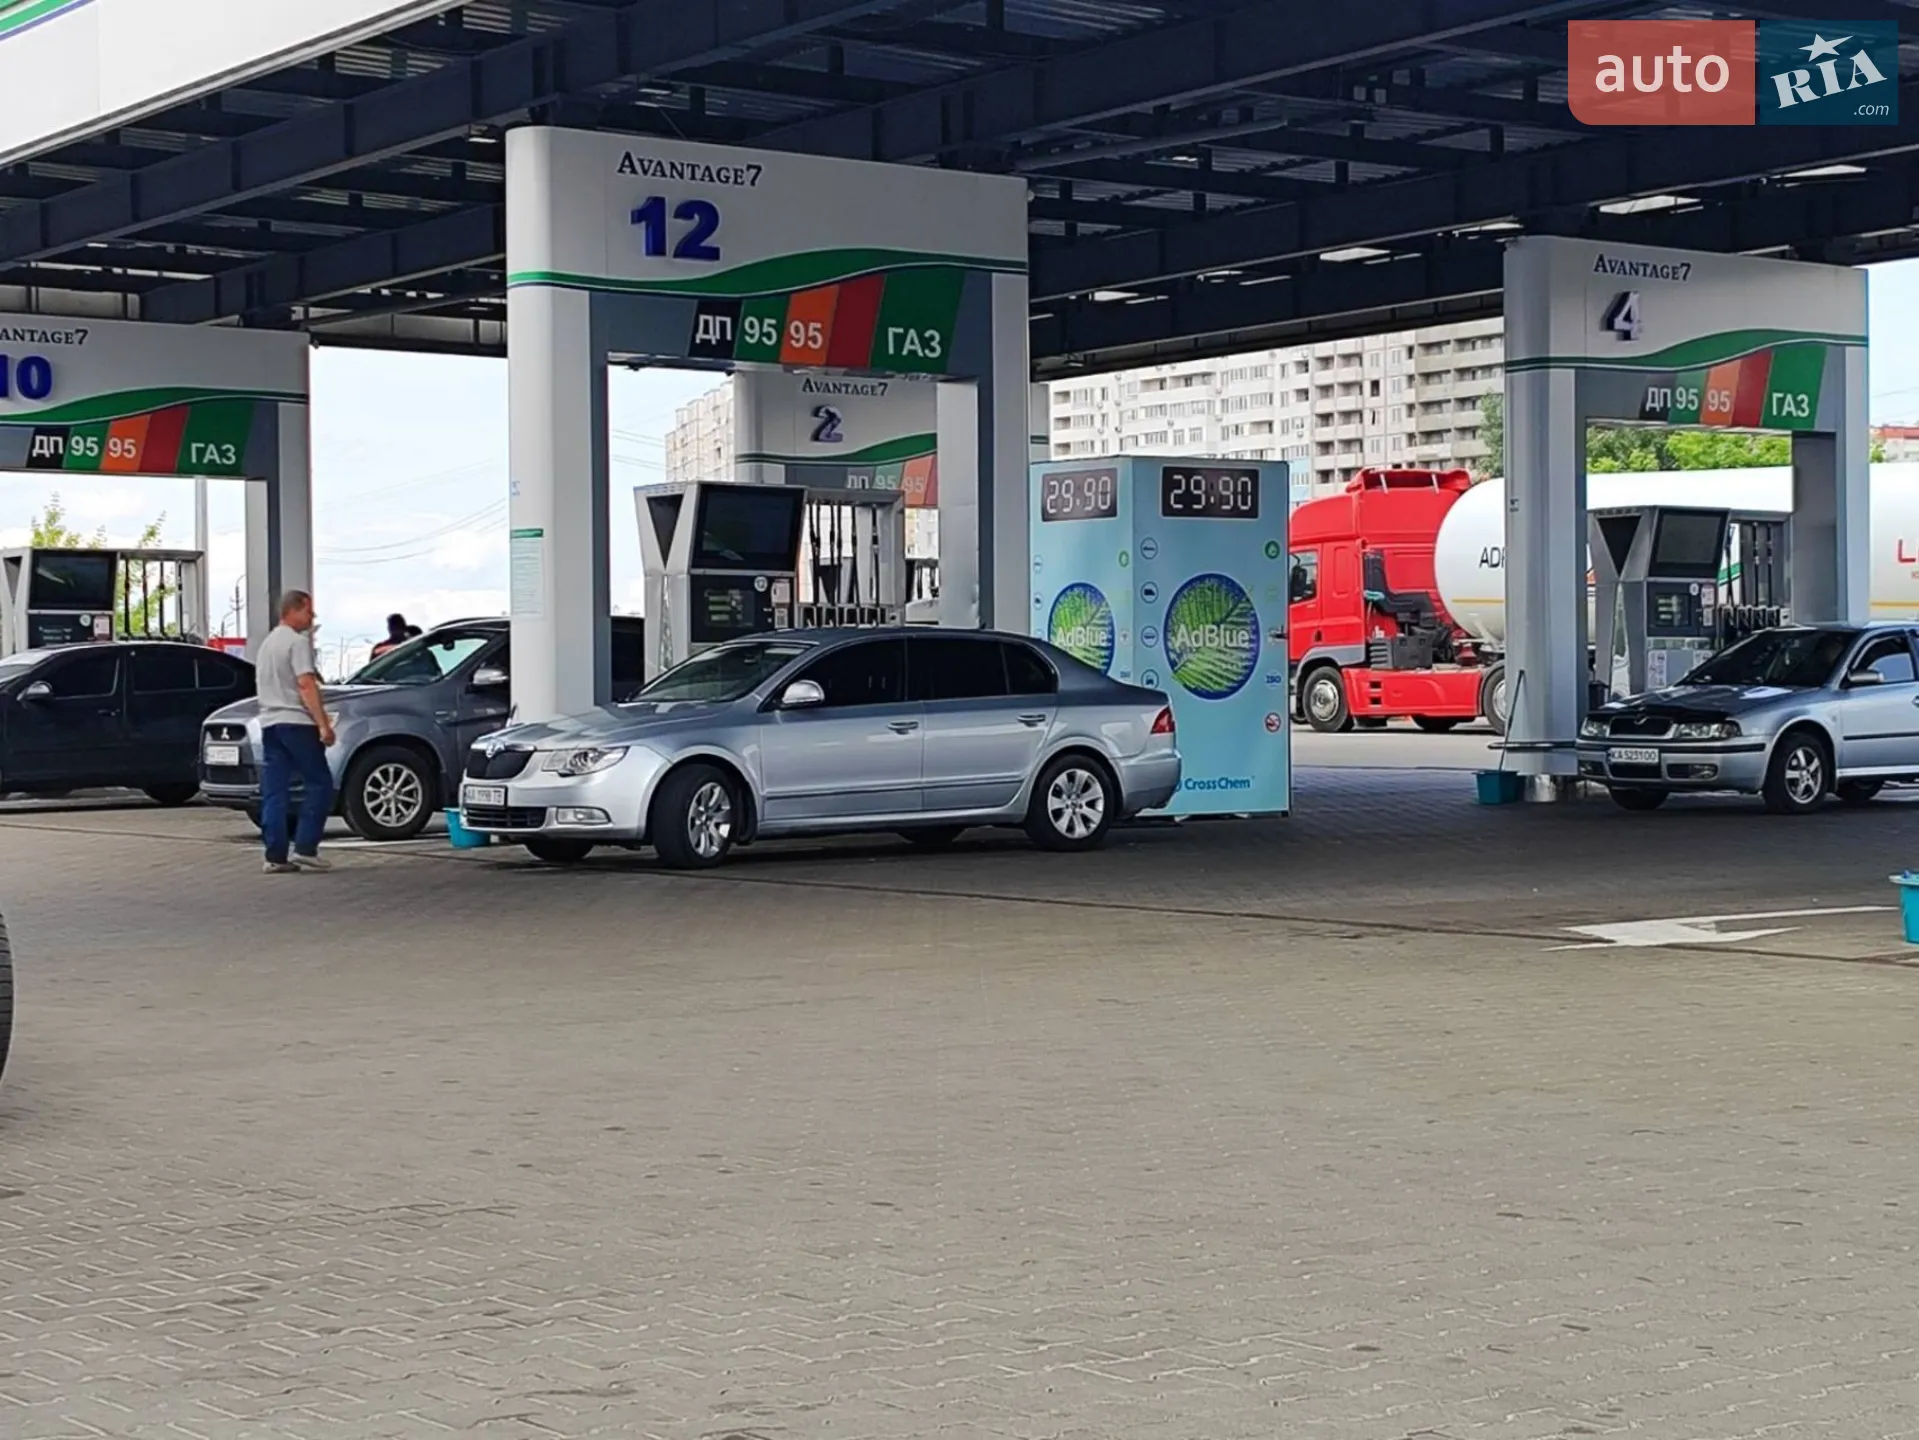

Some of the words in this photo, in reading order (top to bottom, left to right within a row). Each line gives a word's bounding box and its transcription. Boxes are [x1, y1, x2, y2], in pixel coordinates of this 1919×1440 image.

[630, 196, 721, 261] 12
[1600, 291, 1643, 341] 4
[0, 328, 88, 345] ANTAGE7
[695, 314, 732, 345] ДП
[744, 315, 777, 346] 95
[789, 320, 823, 349] 95
[888, 327, 942, 358] ГАЗ
[1646, 387, 1671, 411] ДП
[1676, 387, 1699, 411] 95
[1707, 390, 1732, 412] 95
[1772, 393, 1810, 418] ГАЗ
[810, 404, 844, 442] 2
[32, 436, 64, 458] ДП
[71, 436, 99, 457] 95
[109, 437, 137, 458] 95
[190, 443, 236, 465] ГАЗ
[1046, 476, 1111, 513] 29.90
[1170, 475, 1252, 510] 29.90
[1055, 627, 1108, 648] AdBlue
[1174, 624, 1250, 650] AdBlue
